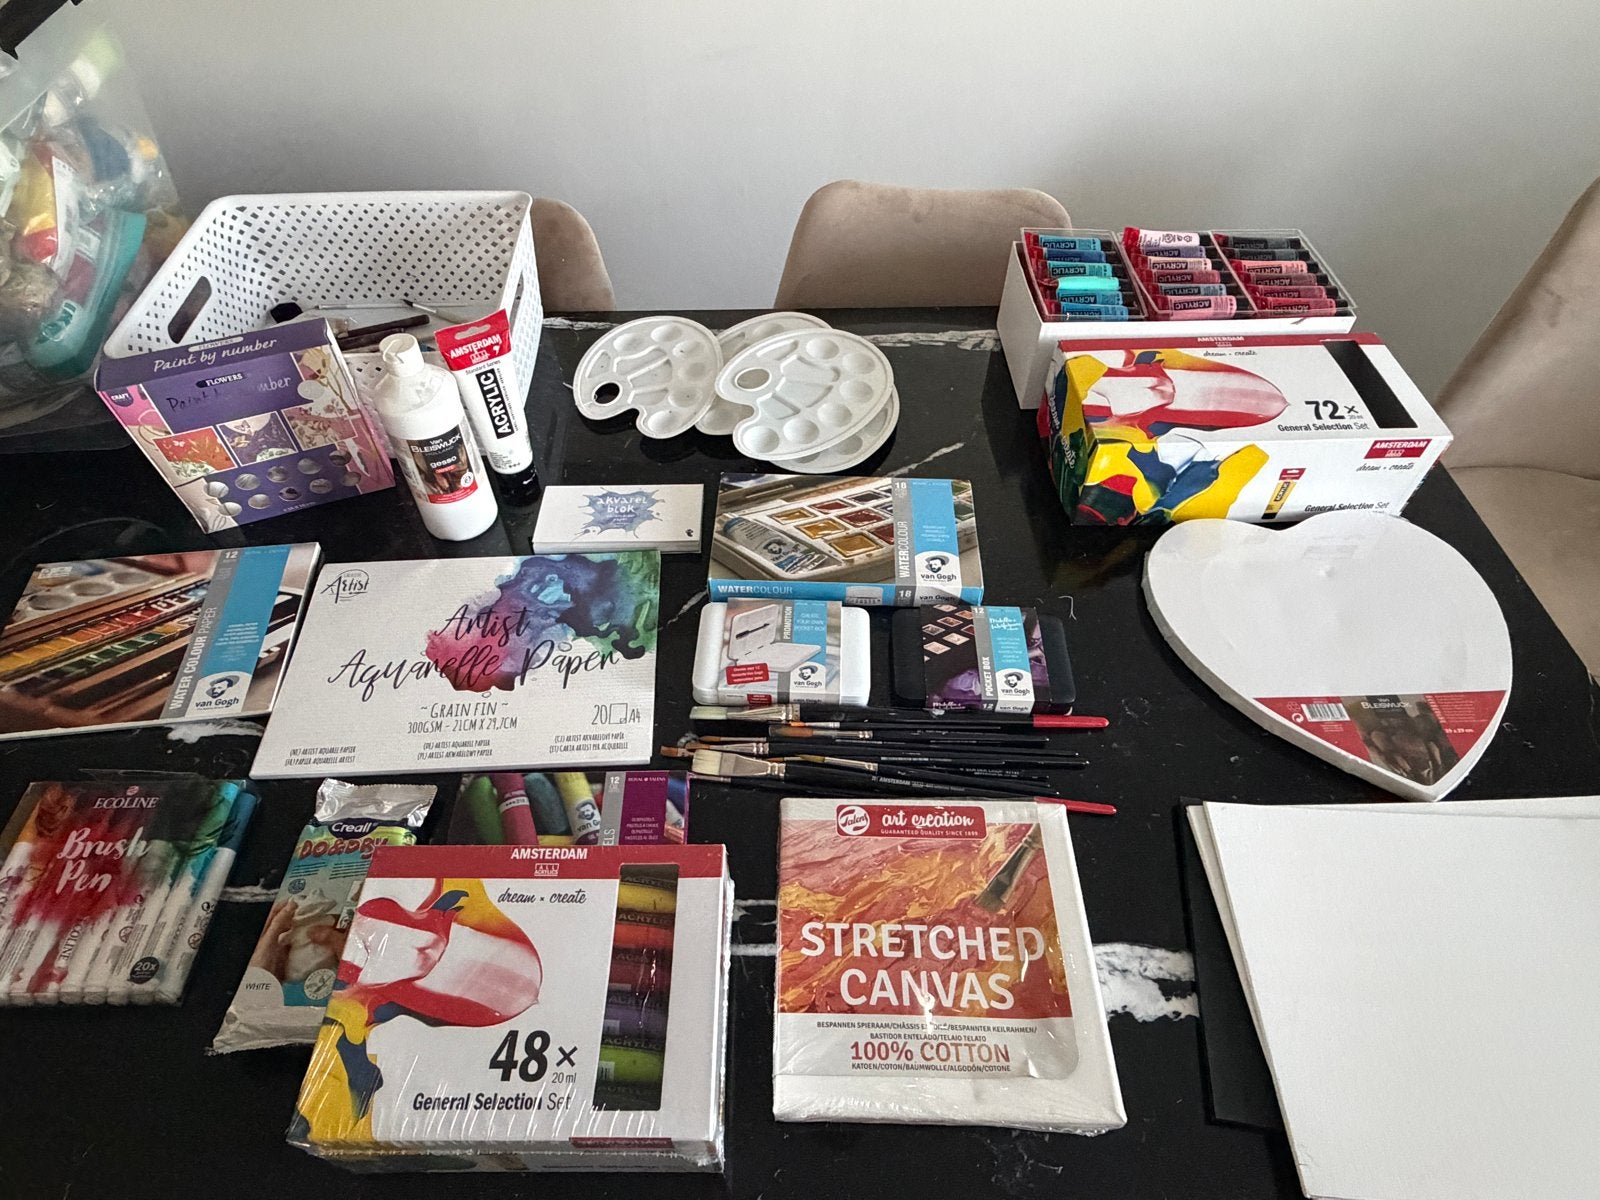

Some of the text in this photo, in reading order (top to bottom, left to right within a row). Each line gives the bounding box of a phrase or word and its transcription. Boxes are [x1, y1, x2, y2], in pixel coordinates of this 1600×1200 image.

[1053, 267, 1085, 275] ACRYLIC
[1153, 262, 1187, 270] ACRYLIC
[1159, 274, 1192, 282] ACRYLIC
[1257, 278, 1290, 286] ACRYLIC
[1165, 287, 1199, 295] ACRYLIC
[1175, 300, 1211, 310] ACRYLIC
[450, 333, 502, 359] AMSTERDAM
[154, 354, 197, 373] Paint
[200, 350, 217, 366] by
[221, 338, 278, 358] number
[466, 359, 502, 375] Standard Series
[206, 372, 243, 387] FLOWERS
[111, 393, 129, 401] CRAFT
[480, 372, 512, 434] ACRYLIC
[1277, 422, 1369, 432] General Selection Set
[1372, 441, 1428, 449] AMSTERDAM
[430, 455, 457, 469] gesso
[597, 496, 648, 505] akvarel
[607, 504, 636, 513] blok
[1304, 504, 1335, 512] General
[225, 551, 238, 559] 12
[899, 521, 911, 579] WATERCOLOUR
[935, 573, 957, 582] Gogh
[717, 584, 794, 595] WATERCOLOUR
[899, 590, 912, 598] 18
[434, 603, 532, 646] Artist
[783, 605, 793, 640] PROMOTION
[169, 606, 217, 710] WATER COLOUR PAPER
[327, 639, 622, 702] Aquarelle Paper
[983, 656, 994, 697] POCKET BOX
[1014, 688, 1030, 696] Gogh
[195, 697, 239, 708] van Gogh
[430, 702, 498, 718] GRAIN FIN
[592, 704, 641, 726] 20 A4
[407, 720, 443, 734] 300GSM
[452, 718, 477, 732] 21CM
[486, 716, 518, 732] 29,7CM
[610, 776, 620, 784] 12
[879, 776, 911, 786] AMSTERDAM
[93, 797, 160, 809] ECOLINE
[881, 809, 975, 829] art creation
[331, 822, 372, 833] Creall
[577, 823, 592, 832] van
[56, 826, 150, 860] Brush
[511, 848, 588, 860] AMSTERDAM
[55, 860, 112, 895] Pen
[497, 887, 587, 904] dream create
[800, 922, 1045, 962] STRETCHED
[135, 961, 157, 971] 20x
[245, 983, 272, 991] WHITE
[839, 969, 1015, 1010] CANVAS
[816, 1021, 856, 1029] BESPANNEN
[870, 1032, 902, 1040] BASTIDOR
[903, 1033, 963, 1041] ENTELADO/TELAIO
[850, 1041, 1010, 1063] 100% COTTON
[551, 1072, 576, 1084] 20 ml
[412, 1092, 571, 1111] General Selection Set
